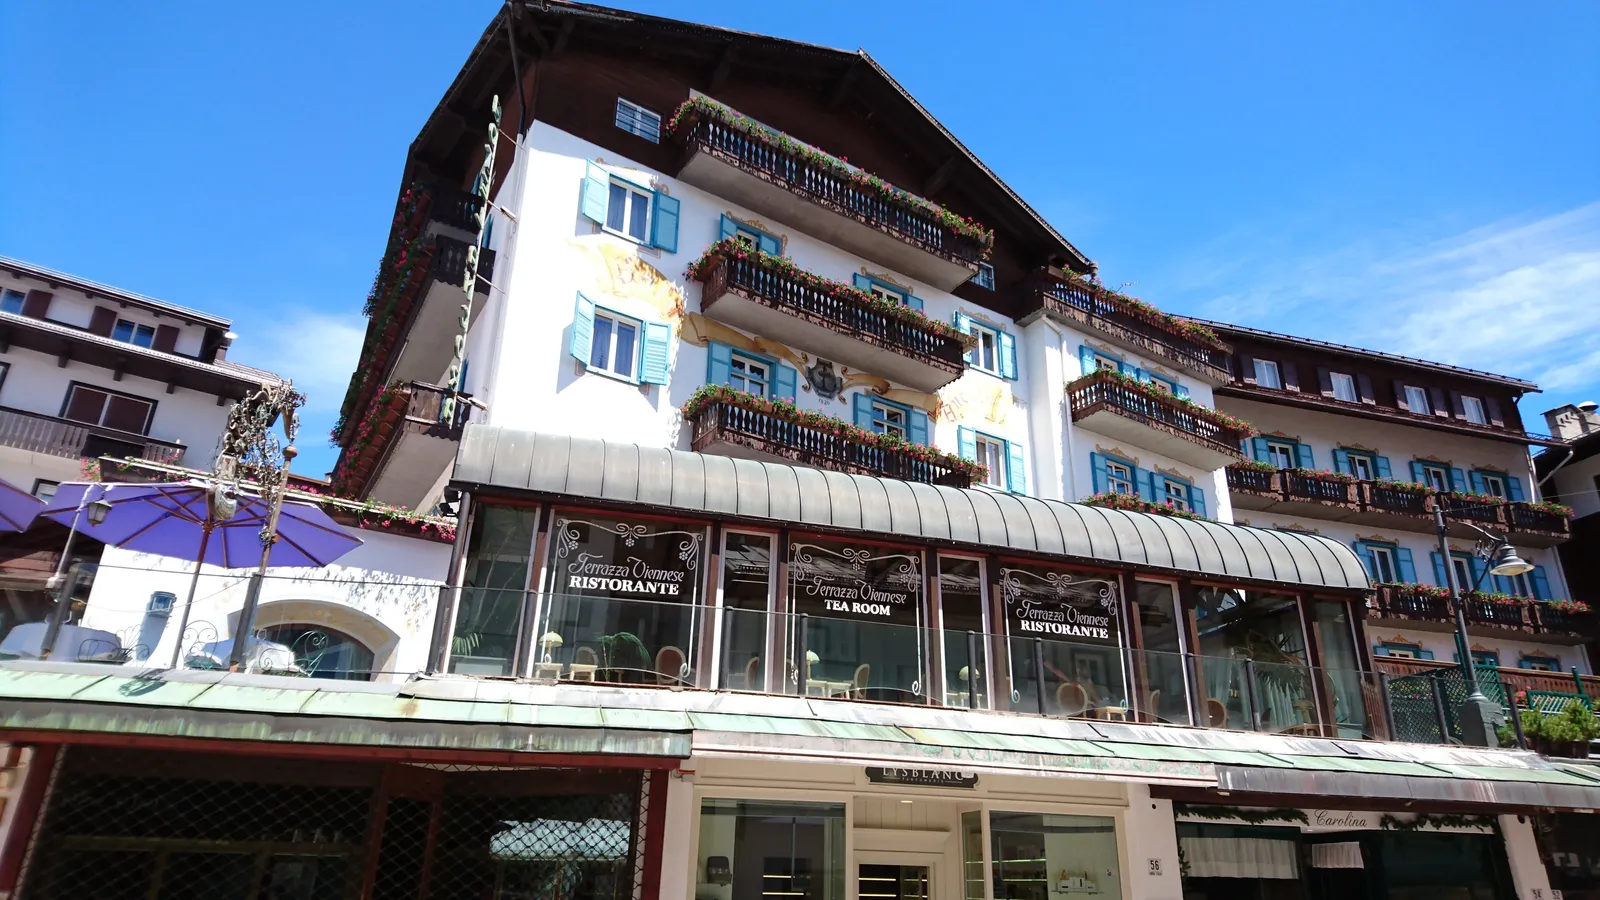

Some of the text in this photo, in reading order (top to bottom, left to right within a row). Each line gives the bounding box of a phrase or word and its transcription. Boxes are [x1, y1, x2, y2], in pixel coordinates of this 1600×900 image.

[568, 552, 685, 582] Terrazza Viennese
[569, 576, 679, 595] RISTORANTE
[806, 576, 907, 604] Terrazza Viennese
[824, 599, 891, 616] TEA ROOM
[1016, 600, 1109, 627] Terrazza Viennese
[1020, 619, 1109, 639] RISTORANTE
[1314, 809, 1367, 827] Carolina
[1150, 860, 1160, 870] 56
